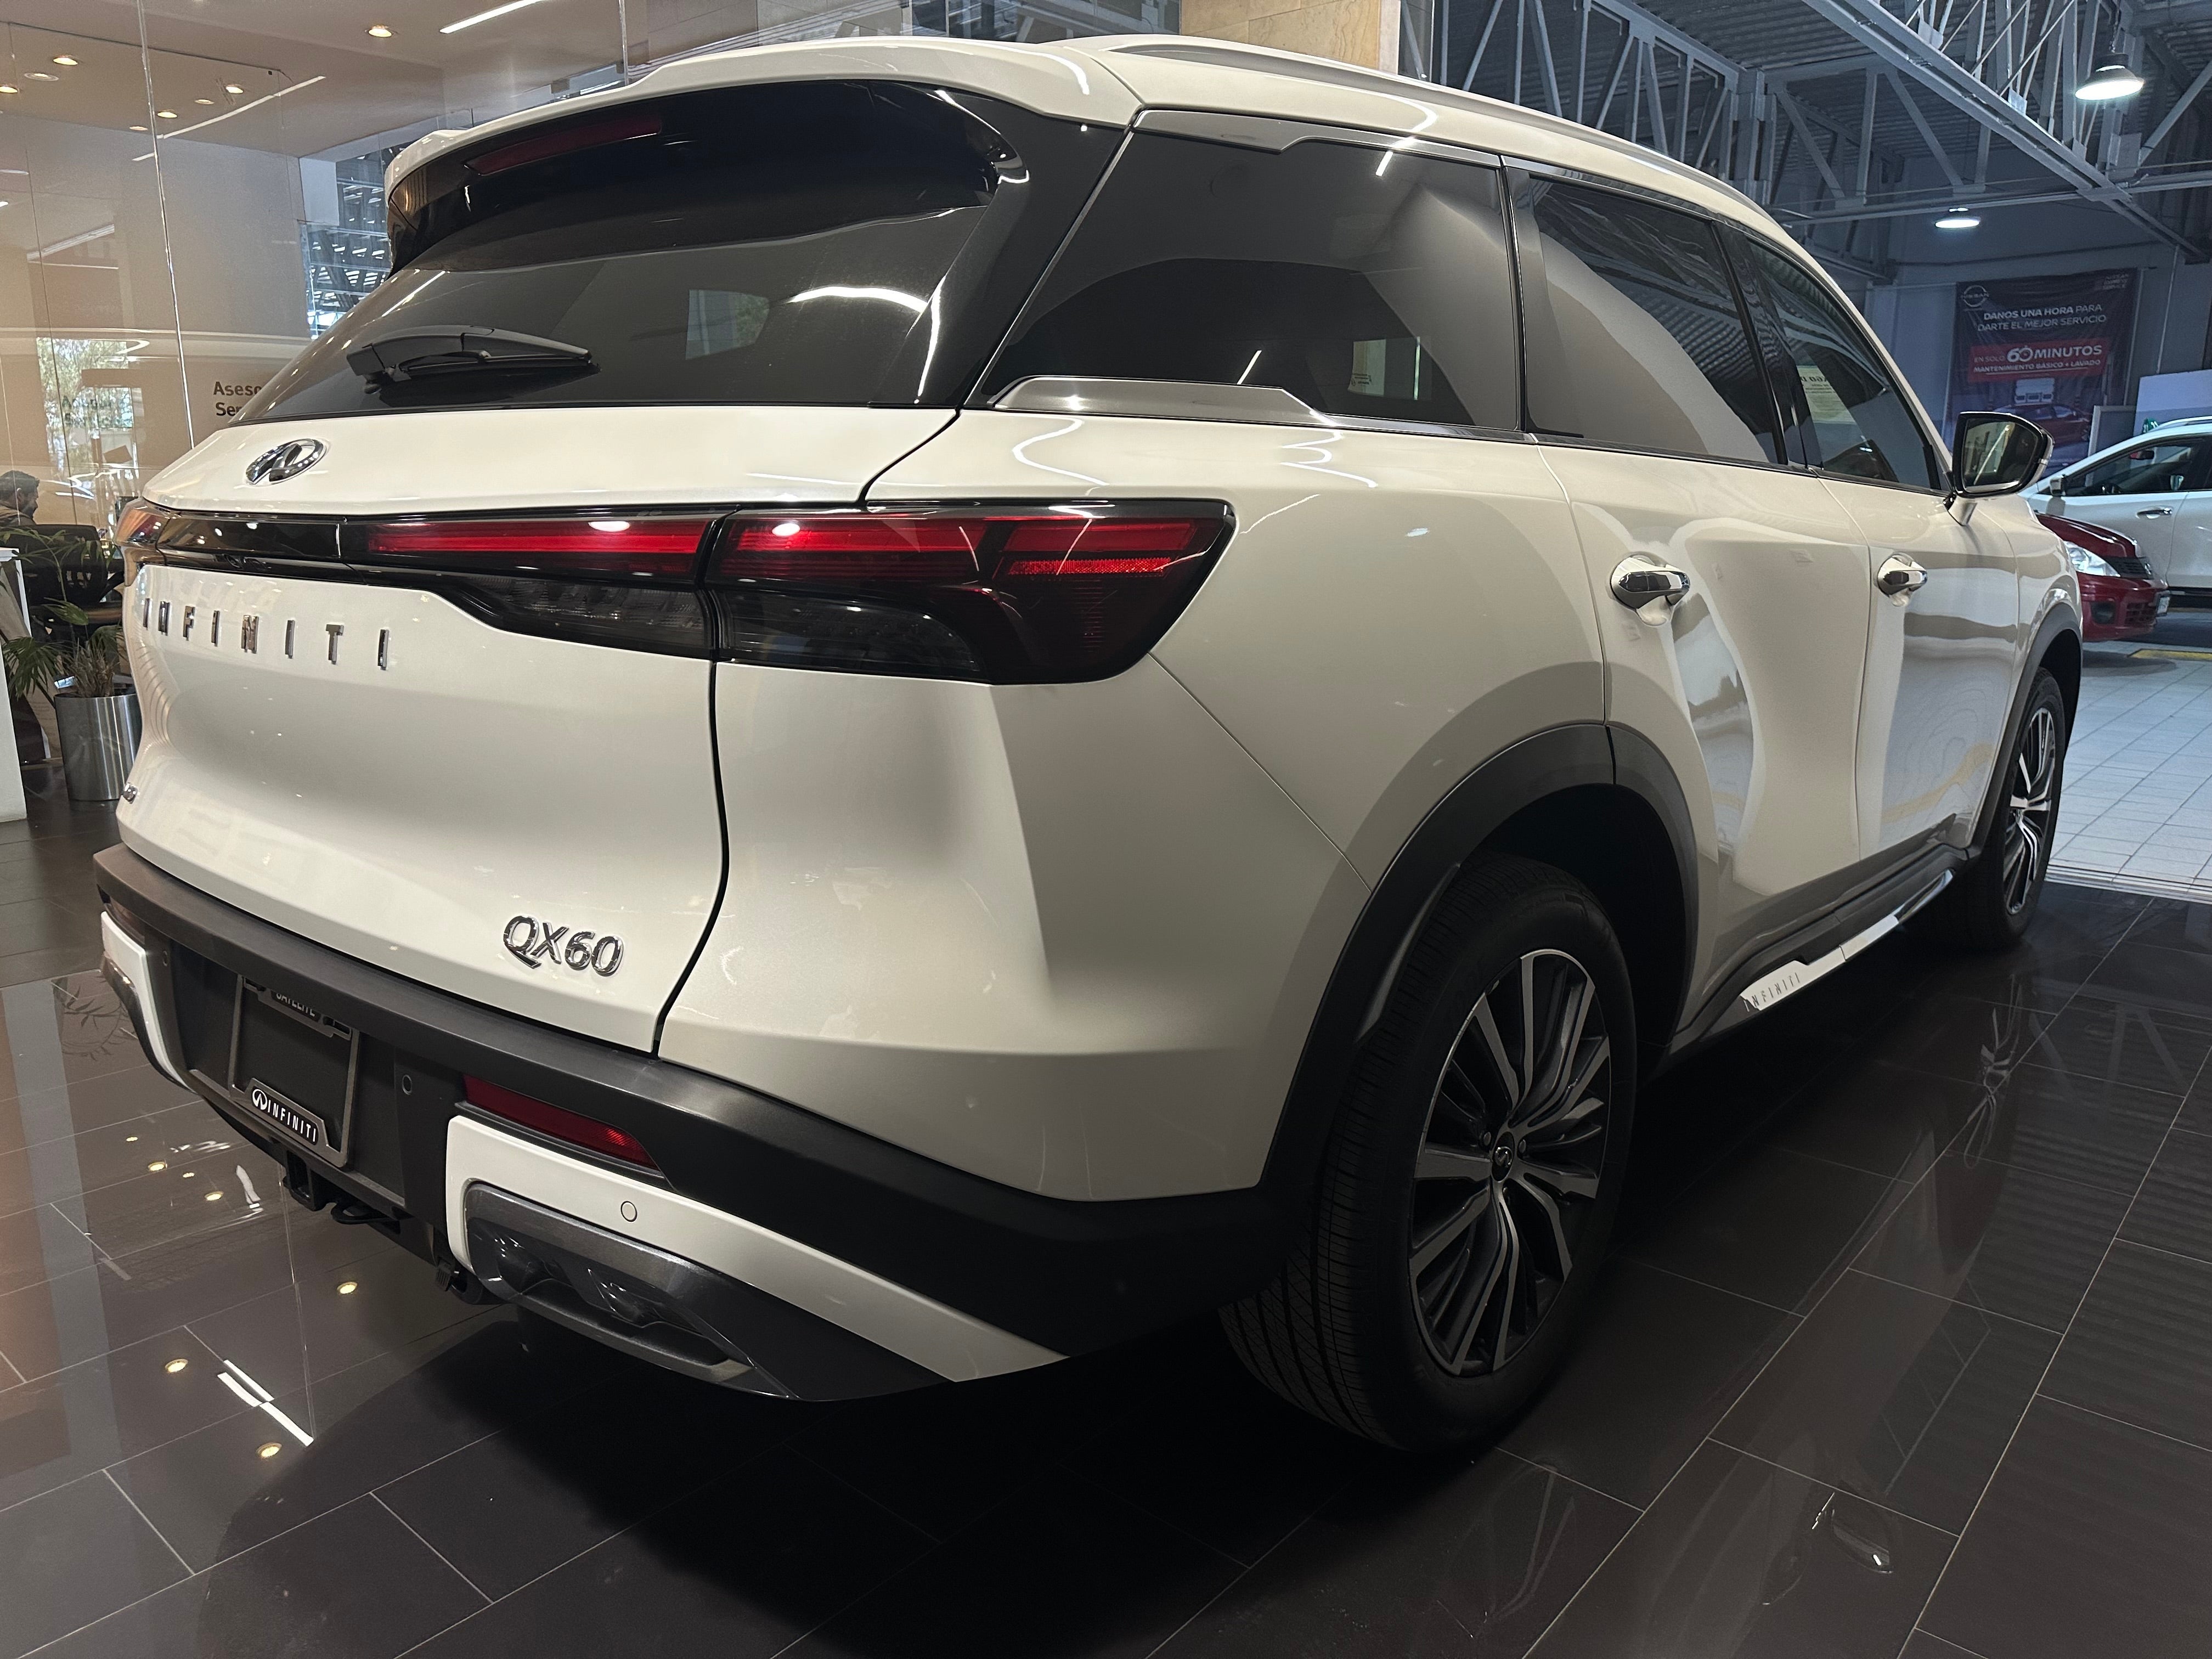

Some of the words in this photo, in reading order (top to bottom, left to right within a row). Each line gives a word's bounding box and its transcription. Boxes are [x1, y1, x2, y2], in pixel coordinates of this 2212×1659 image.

[1977, 321, 2009, 331] DARTE
[2011, 320, 2022, 329] EL
[2024, 318, 2058, 329] MEJOR
[2059, 314, 2107, 326] SERVICIO
[1983, 311, 2018, 320] DANOS
[2021, 308, 2042, 318] UNA
[2044, 306, 2074, 317] HORA
[2075, 304, 2102, 313] PARA
[1974, 363, 2034, 373] MANTENIMIENTO
[2070, 359, 2101, 368] LAVADO
[2006, 345, 2033, 363] 60
[2033, 345, 2102, 359] MINUTOS
[143, 598, 390, 671] INFINITI
[503, 915, 624, 977] QX60
[1743, 972, 1801, 1012] INFINITI
[267, 1099, 317, 1143] INFINITI
